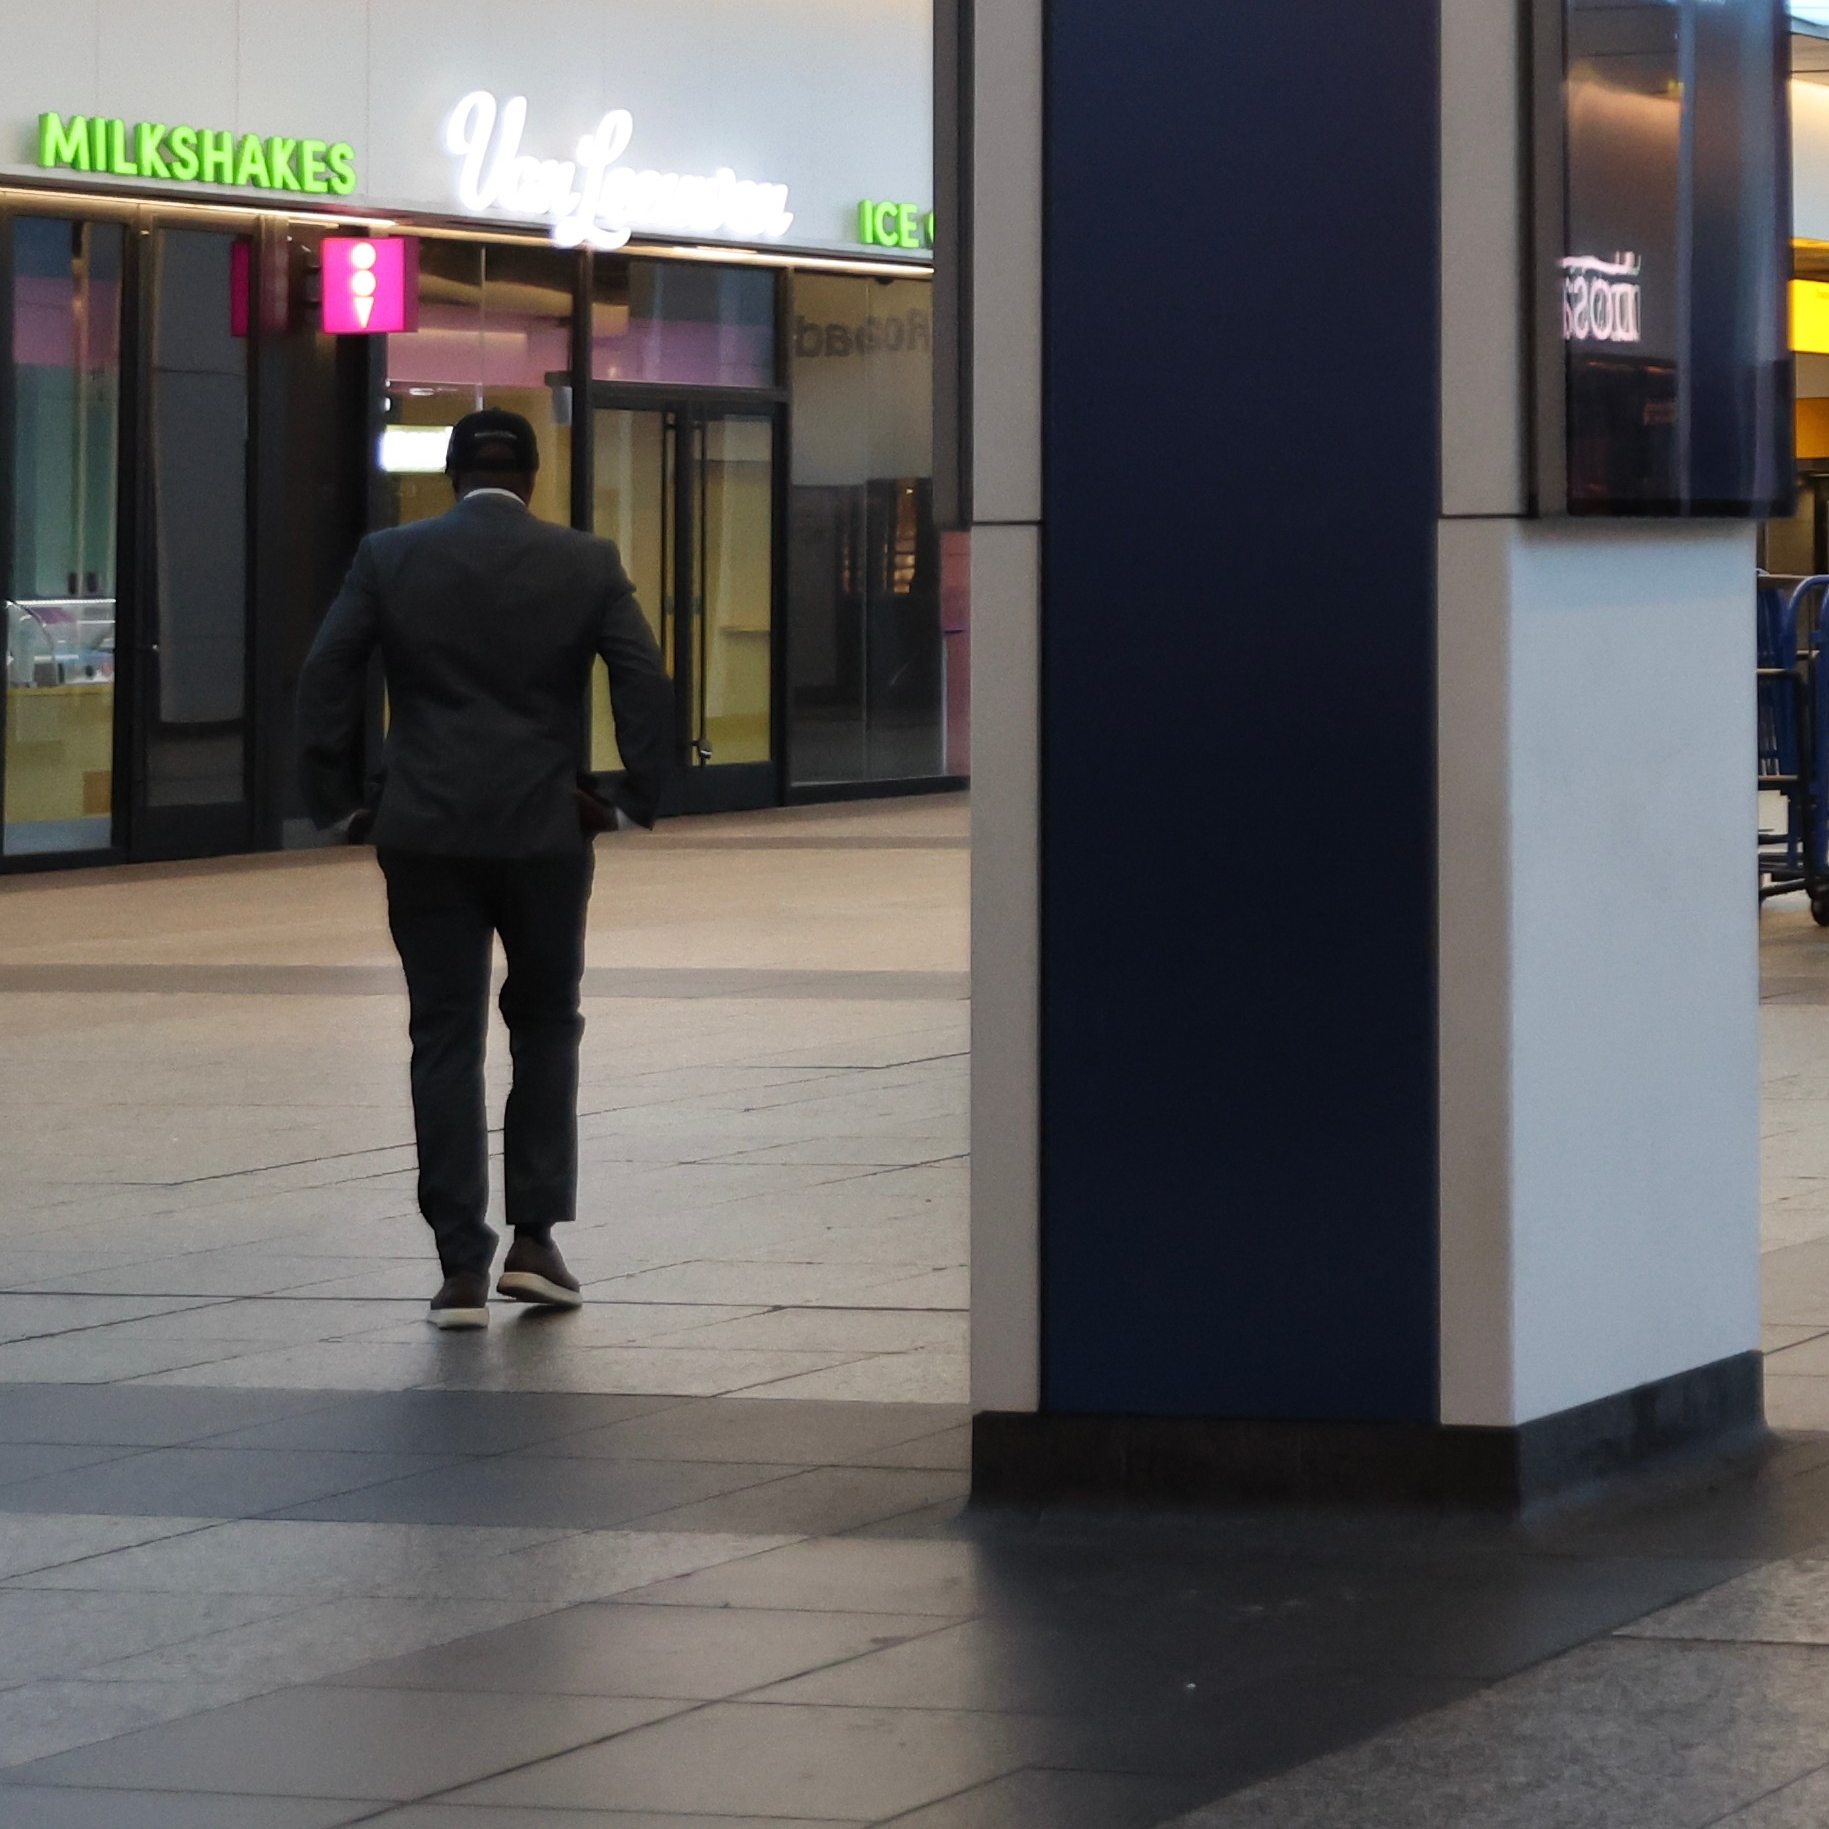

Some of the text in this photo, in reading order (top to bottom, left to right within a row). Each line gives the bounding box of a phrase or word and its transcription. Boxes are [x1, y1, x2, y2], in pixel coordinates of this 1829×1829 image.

[37, 112, 357, 196] MILKSHAKES
[446, 90, 581, 214] Van
[857, 199, 920, 248] ICE
